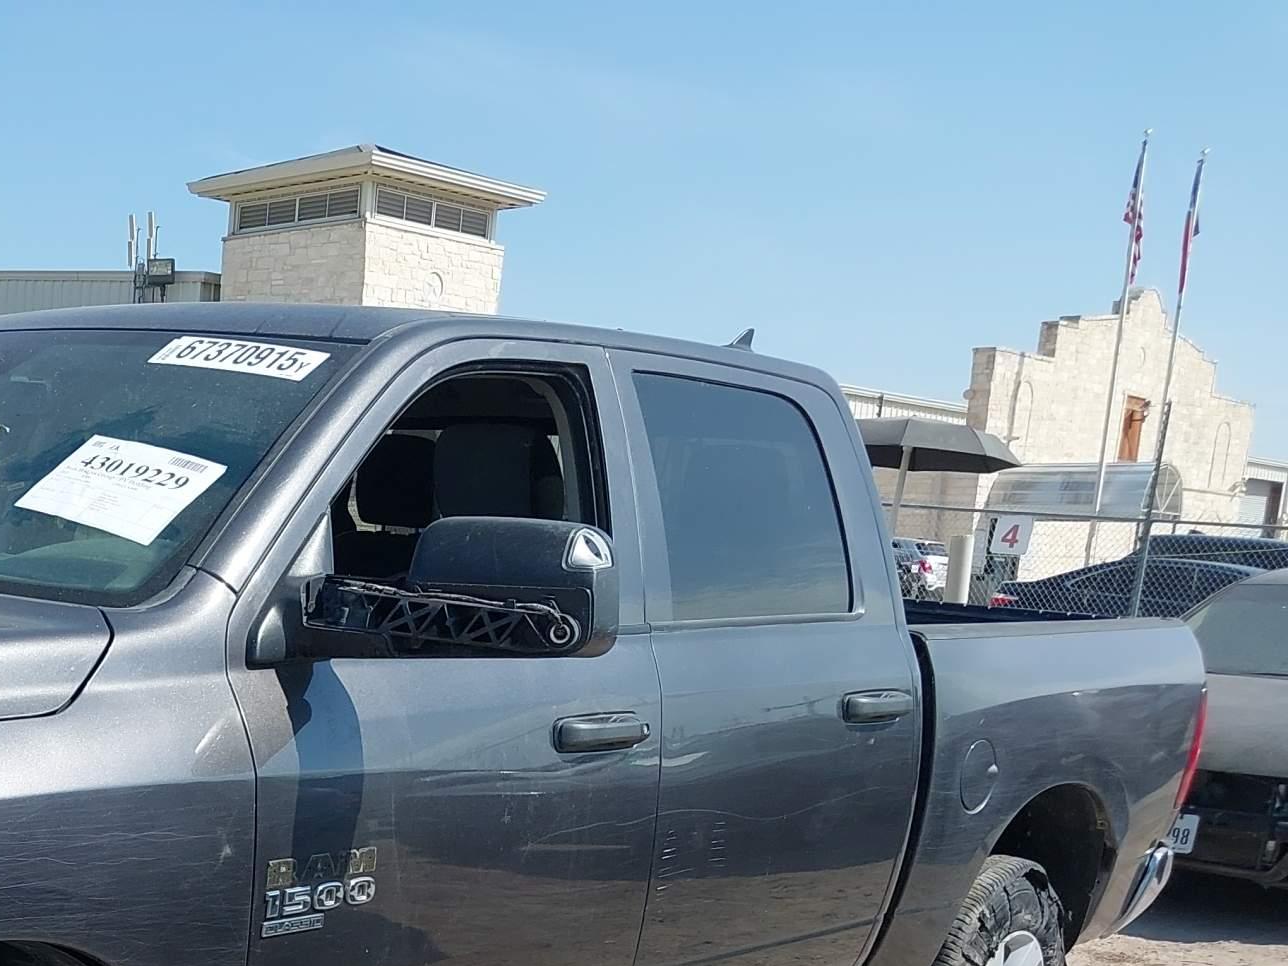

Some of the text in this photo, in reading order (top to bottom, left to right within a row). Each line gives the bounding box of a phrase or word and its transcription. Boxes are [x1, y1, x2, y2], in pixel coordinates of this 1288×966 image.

[80, 454, 190, 490] 43019229
[1000, 524, 1021, 549] 4
[265, 846, 377, 888] RAM
[264, 875, 376, 918] 1500
